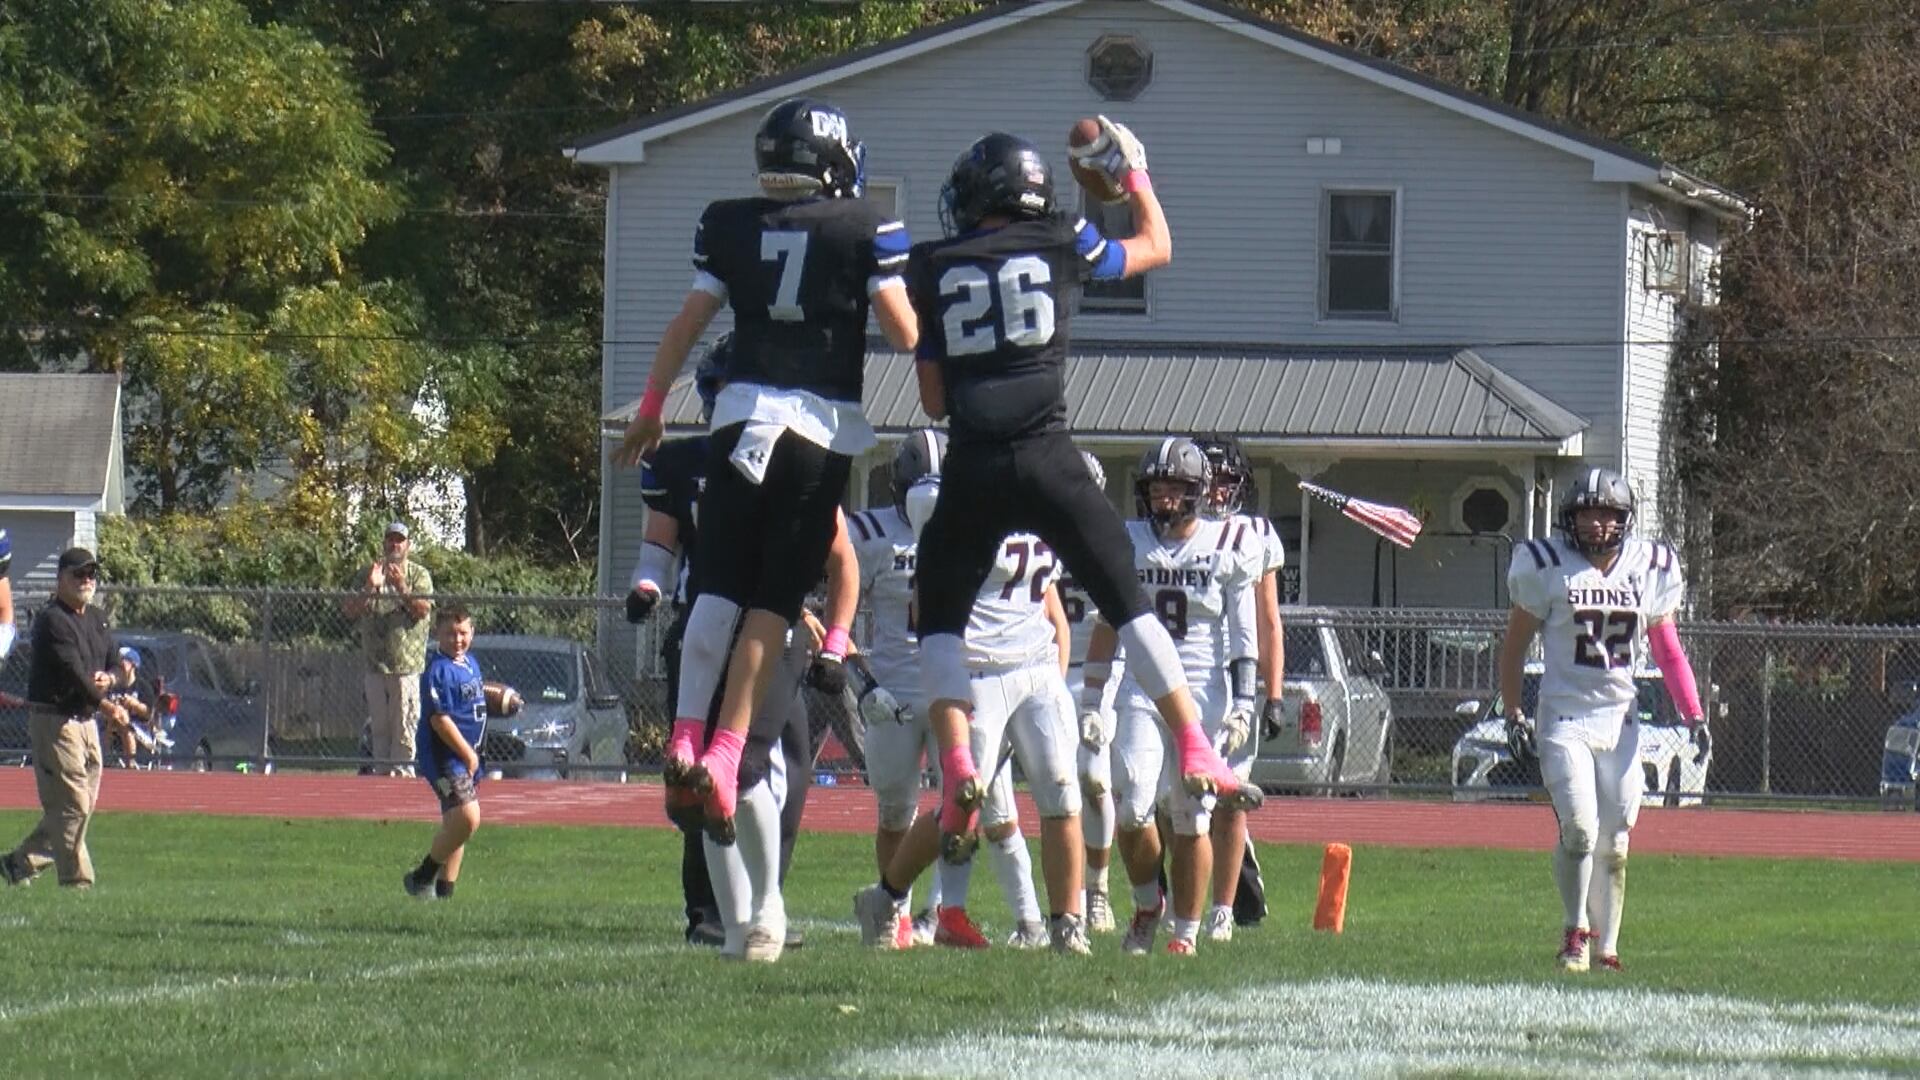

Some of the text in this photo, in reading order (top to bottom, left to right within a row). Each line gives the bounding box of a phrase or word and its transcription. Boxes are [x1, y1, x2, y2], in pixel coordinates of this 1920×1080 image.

[760, 231, 808, 321] 7
[939, 255, 1055, 356] 26
[999, 541, 1057, 602] 72
[1136, 569, 1210, 587] SIDNEY
[1568, 589, 1643, 608] SIDNEY
[1573, 608, 1638, 670] 22
